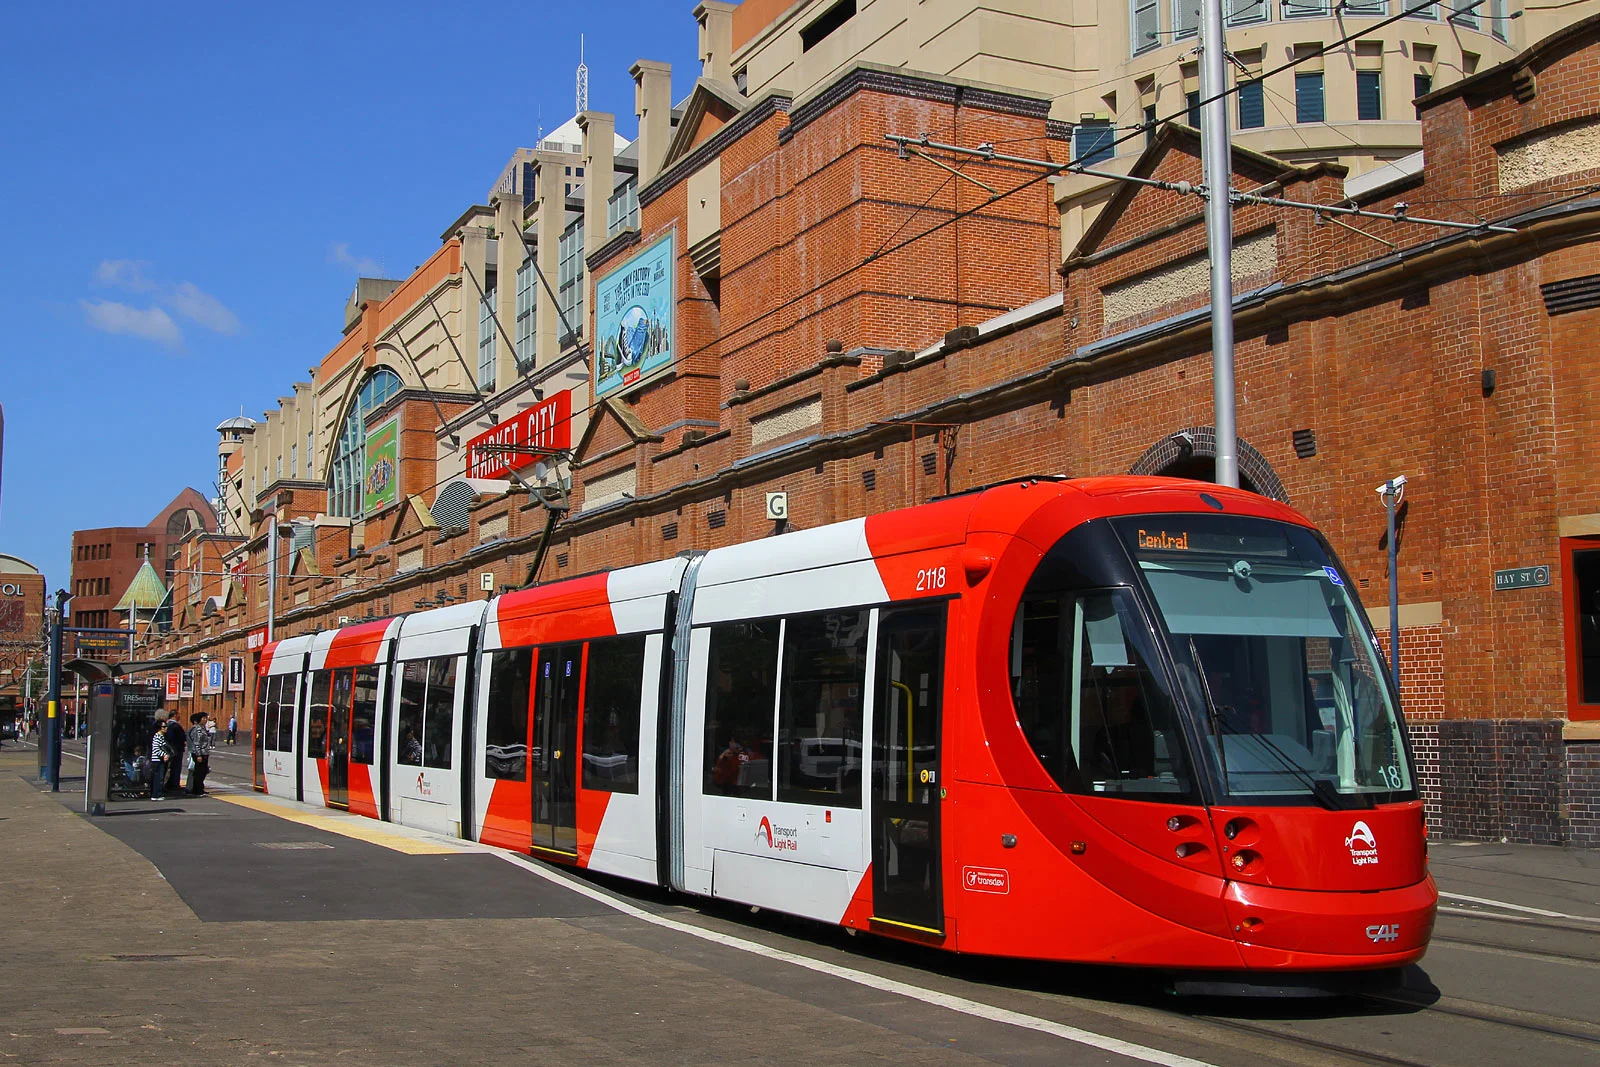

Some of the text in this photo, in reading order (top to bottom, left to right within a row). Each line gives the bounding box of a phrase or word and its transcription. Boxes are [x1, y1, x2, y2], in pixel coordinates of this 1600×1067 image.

[622, 272, 632, 291] ONLY
[632, 266, 651, 284] FACTORY
[615, 288, 630, 315] OUTLETS
[630, 284, 634, 300] IN
[642, 282, 650, 297] CBD
[472, 402, 556, 478] MARKET CITY
[770, 494, 784, 516] G
[1138, 530, 1189, 550] Central
[483, 574, 490, 588] F
[916, 566, 946, 591] 2118
[1497, 572, 1530, 584] HAY ST
[0, 584, 24, 596] OL
[1378, 766, 1401, 789] 18
[773, 824, 798, 838] Transport
[774, 838, 798, 851] Light Rail
[1352, 858, 1367, 866] Light
[978, 876, 1004, 886] transdev
[1366, 924, 1400, 942] CAF
